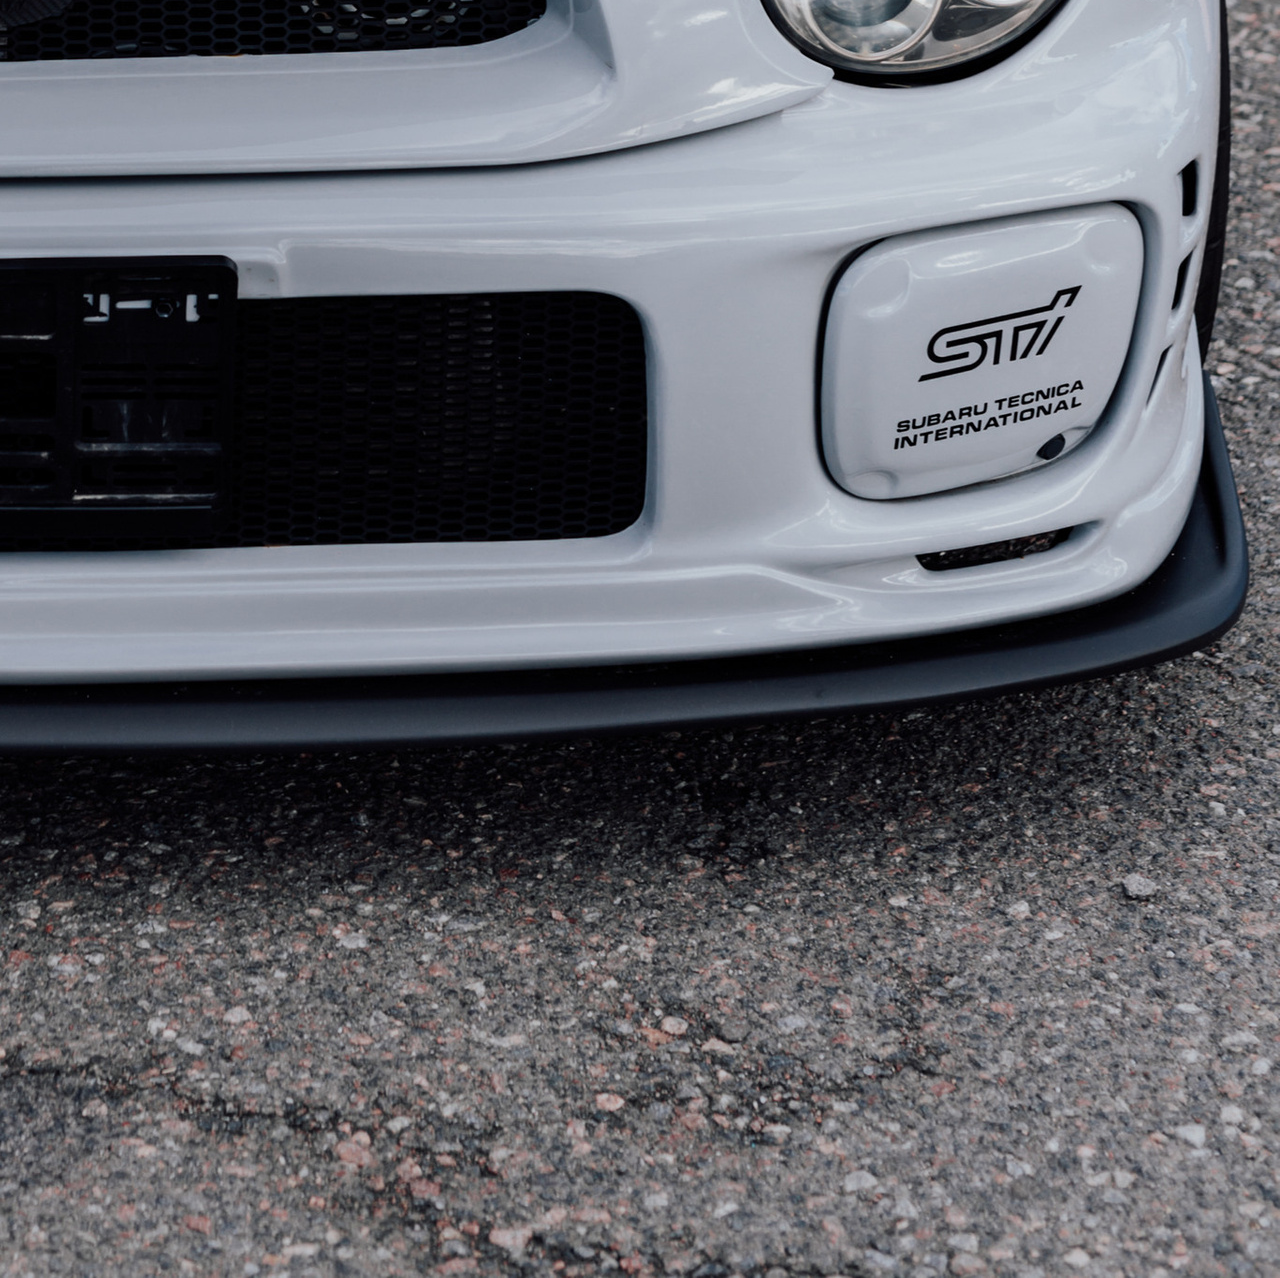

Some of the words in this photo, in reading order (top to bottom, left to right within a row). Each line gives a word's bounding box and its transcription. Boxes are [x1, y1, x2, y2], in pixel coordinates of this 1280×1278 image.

[893, 396, 1083, 451] INTERNATIONAL
[895, 401, 989, 434] SUBARU
[994, 380, 1085, 412] TECNICA
